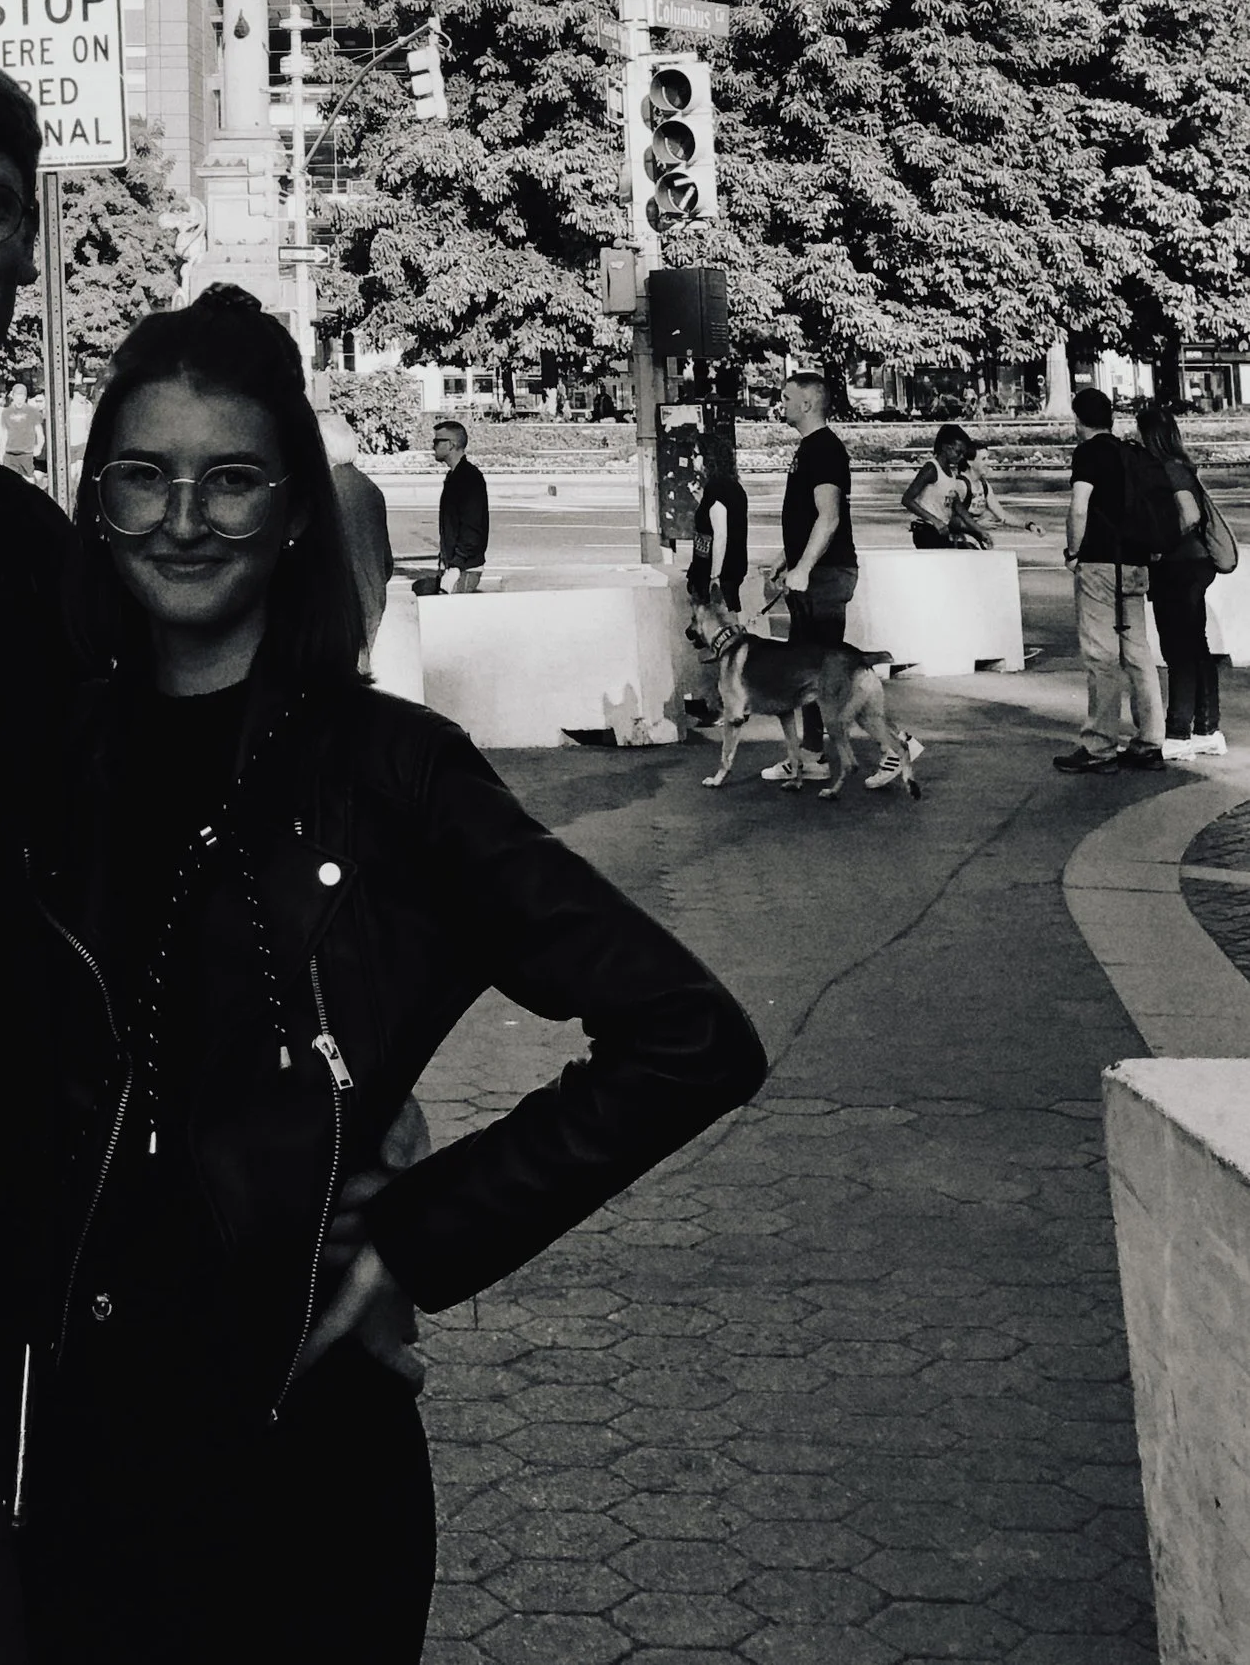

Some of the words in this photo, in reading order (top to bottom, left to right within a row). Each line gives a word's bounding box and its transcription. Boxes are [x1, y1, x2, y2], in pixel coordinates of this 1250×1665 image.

[656, 0, 711, 30] Columbus
[72, 34, 110, 63] ON
[41, 117, 112, 148] NAL
